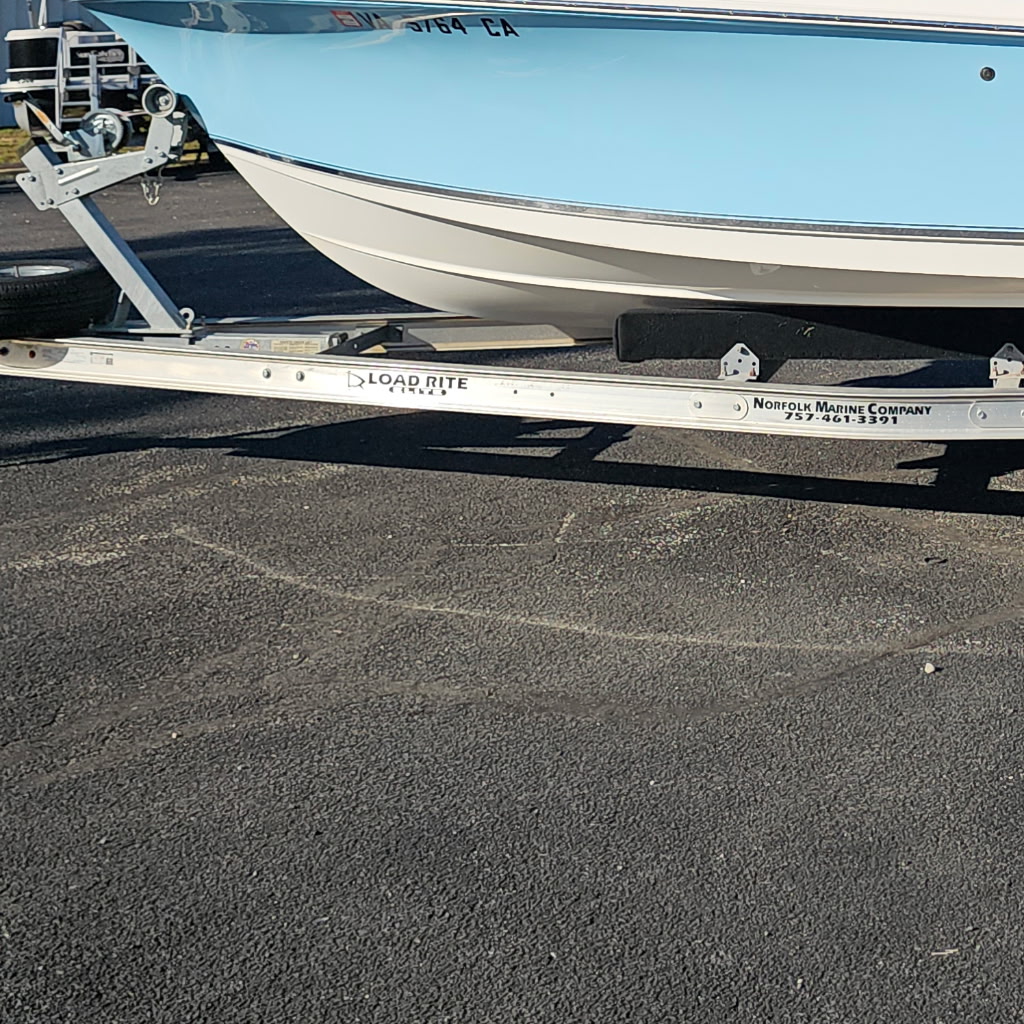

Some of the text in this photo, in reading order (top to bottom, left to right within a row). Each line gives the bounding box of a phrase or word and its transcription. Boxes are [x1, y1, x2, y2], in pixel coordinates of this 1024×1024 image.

[356, 11, 393, 30] VA
[480, 17, 520, 37] CA
[368, 372, 468, 389] LOAD RITE
[753, 397, 932, 416] NORFOLK MARINE COMPANY
[785, 411, 898, 425] 757-461-3391
